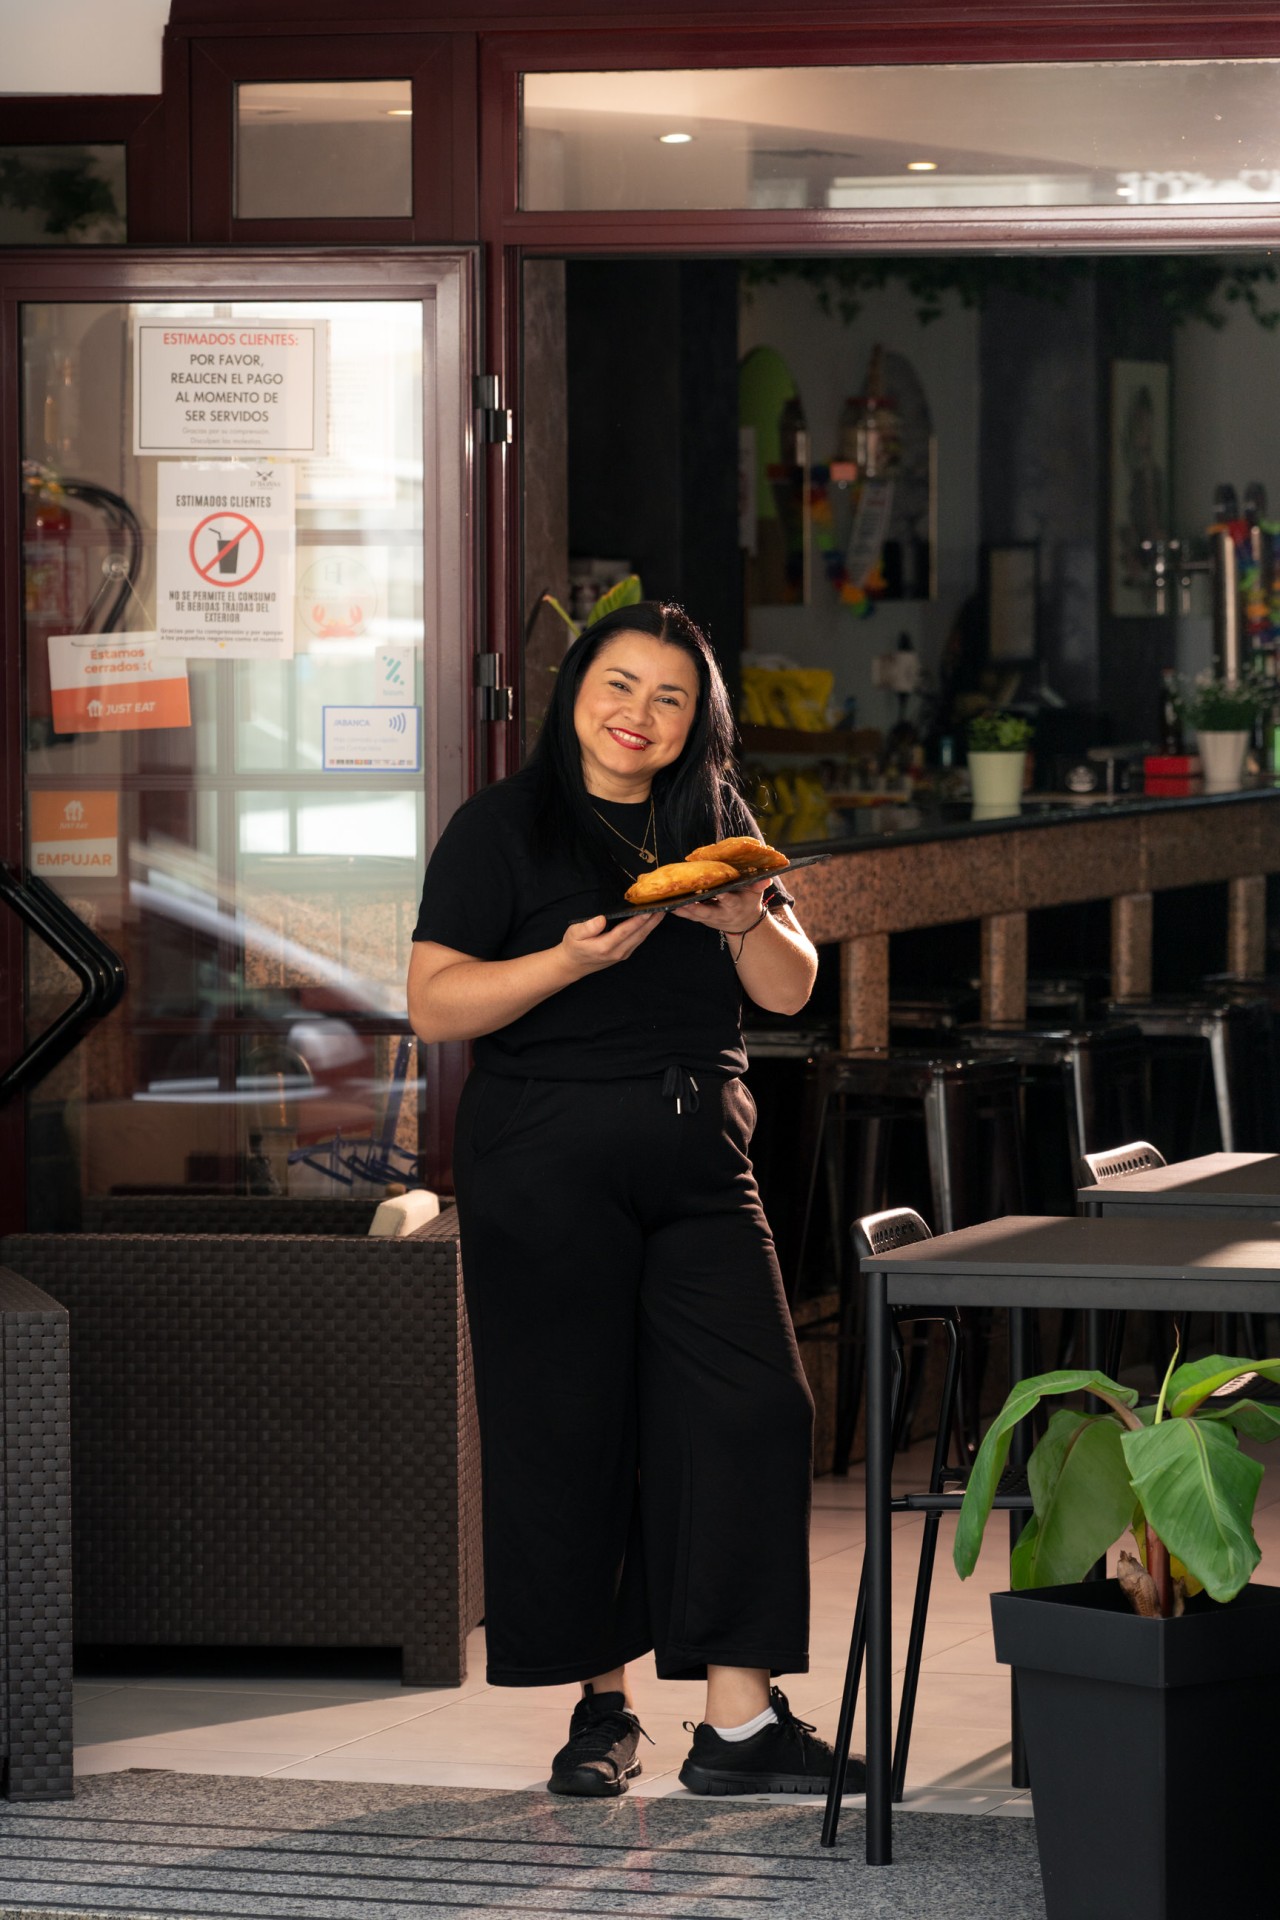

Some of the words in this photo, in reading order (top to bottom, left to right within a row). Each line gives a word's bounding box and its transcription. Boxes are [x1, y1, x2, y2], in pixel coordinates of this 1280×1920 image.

[163, 333, 236, 345] ESTIMADOS
[239, 333, 299, 346] CLIENTES:
[190, 354, 215, 366] POR
[219, 354, 264, 367] FAVOR,
[171, 373, 227, 385] REALICEN
[231, 373, 243, 385] EL
[247, 373, 284, 385] PAGO
[175, 391, 190, 403] AL
[193, 391, 260, 403] MOMENTO
[263, 392, 279, 403] DE
[185, 410, 206, 422] SER
[210, 410, 269, 422] SERVIDOS
[176, 495, 228, 507] ESTIMADOS
[230, 496, 271, 508] CLIENTES
[169, 590, 180, 600] NO
[181, 590, 191, 601] SE
[193, 591, 226, 601] PERMITE
[228, 592, 235, 601] EL
[238, 592, 277, 602] CONSUMO
[175, 601, 185, 611] DE
[187, 602, 220, 612] BEBIDAS
[256, 603, 270, 613] DEL
[204, 613, 240, 623] EXTERIOR
[90, 648, 145, 660] Estamos
[84, 661, 140, 674] cerrados
[106, 703, 133, 715] JUST
[134, 702, 157, 713] EAT
[37, 853, 113, 866] EMPUJAR
